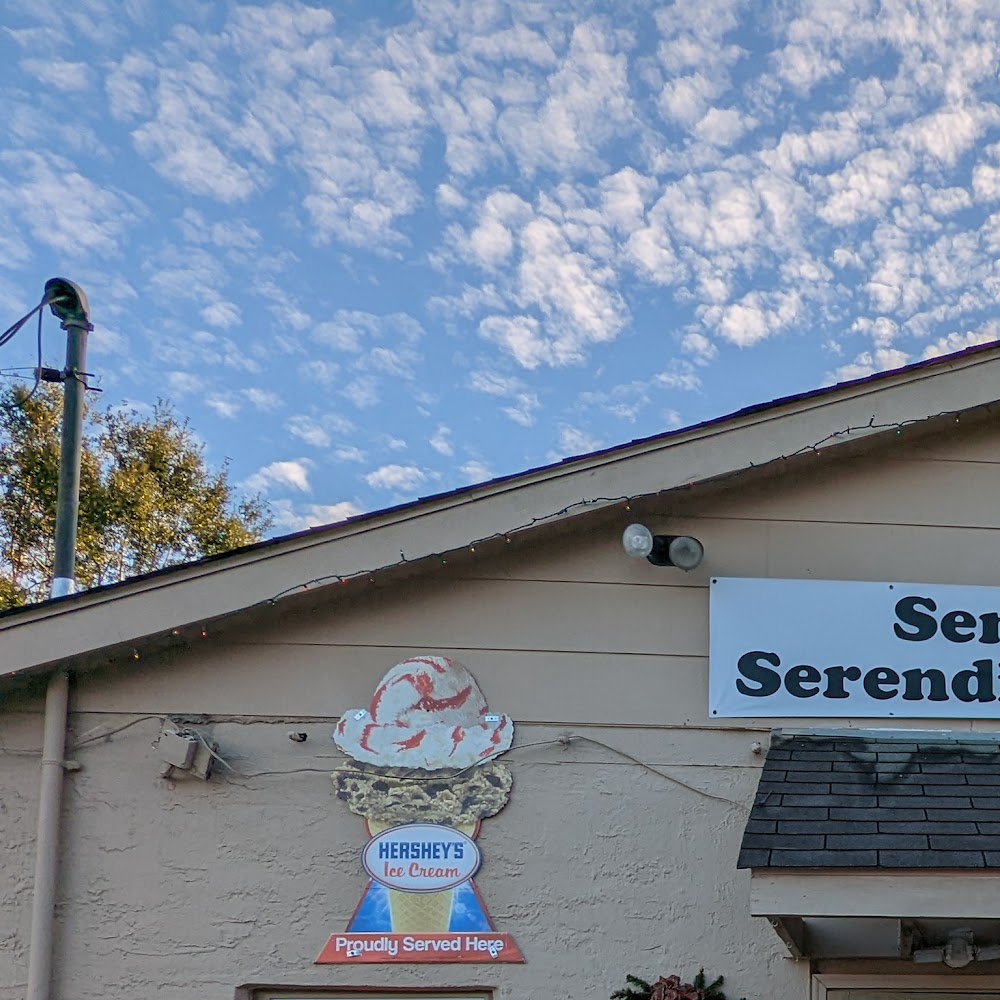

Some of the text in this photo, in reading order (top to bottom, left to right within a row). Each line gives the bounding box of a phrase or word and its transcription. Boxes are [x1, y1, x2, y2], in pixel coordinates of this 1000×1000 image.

[378, 841, 465, 860] HERSHEY'S
[384, 861, 461, 879] Ice Cream
[335, 936, 504, 956] Proudly Served Here
